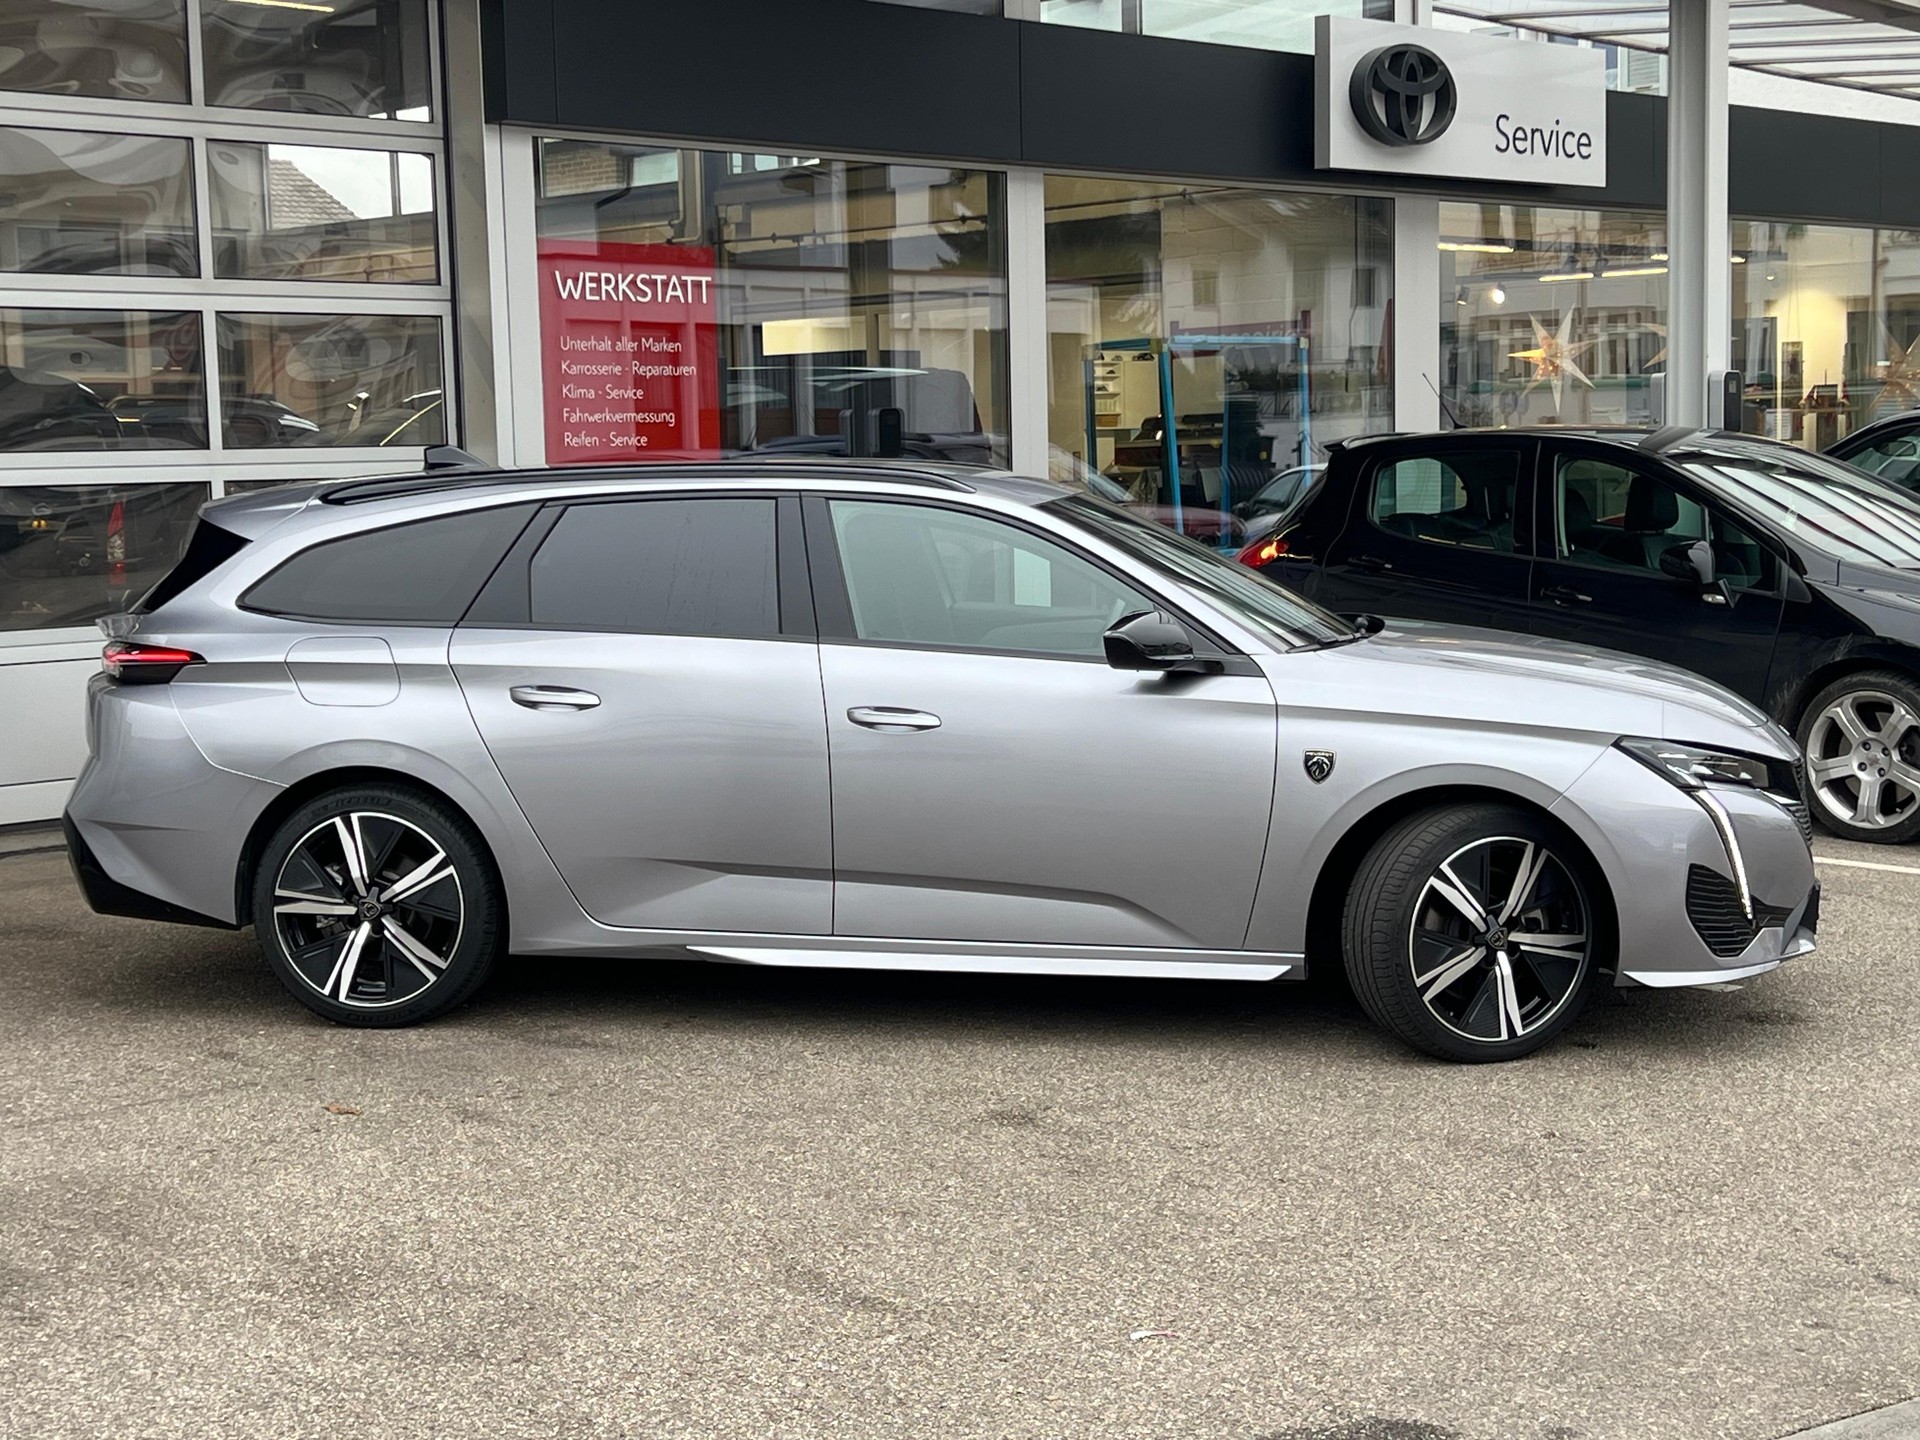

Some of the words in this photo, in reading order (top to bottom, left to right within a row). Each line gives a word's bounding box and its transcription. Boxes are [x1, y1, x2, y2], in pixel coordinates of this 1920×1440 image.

[1495, 114, 1592, 160] Service
[555, 270, 712, 304] WERKSTATT
[560, 336, 612, 352] Unterhalt
[615, 337, 638, 352] aller
[641, 337, 682, 353] Marken
[561, 360, 622, 375] Karrosserie
[632, 361, 697, 379] Reparaturen
[562, 384, 595, 399] Klima
[606, 384, 644, 399] Service
[563, 408, 675, 427] Fahrwerkvermessung
[564, 432, 599, 447] Reifen
[610, 432, 648, 447] Service
